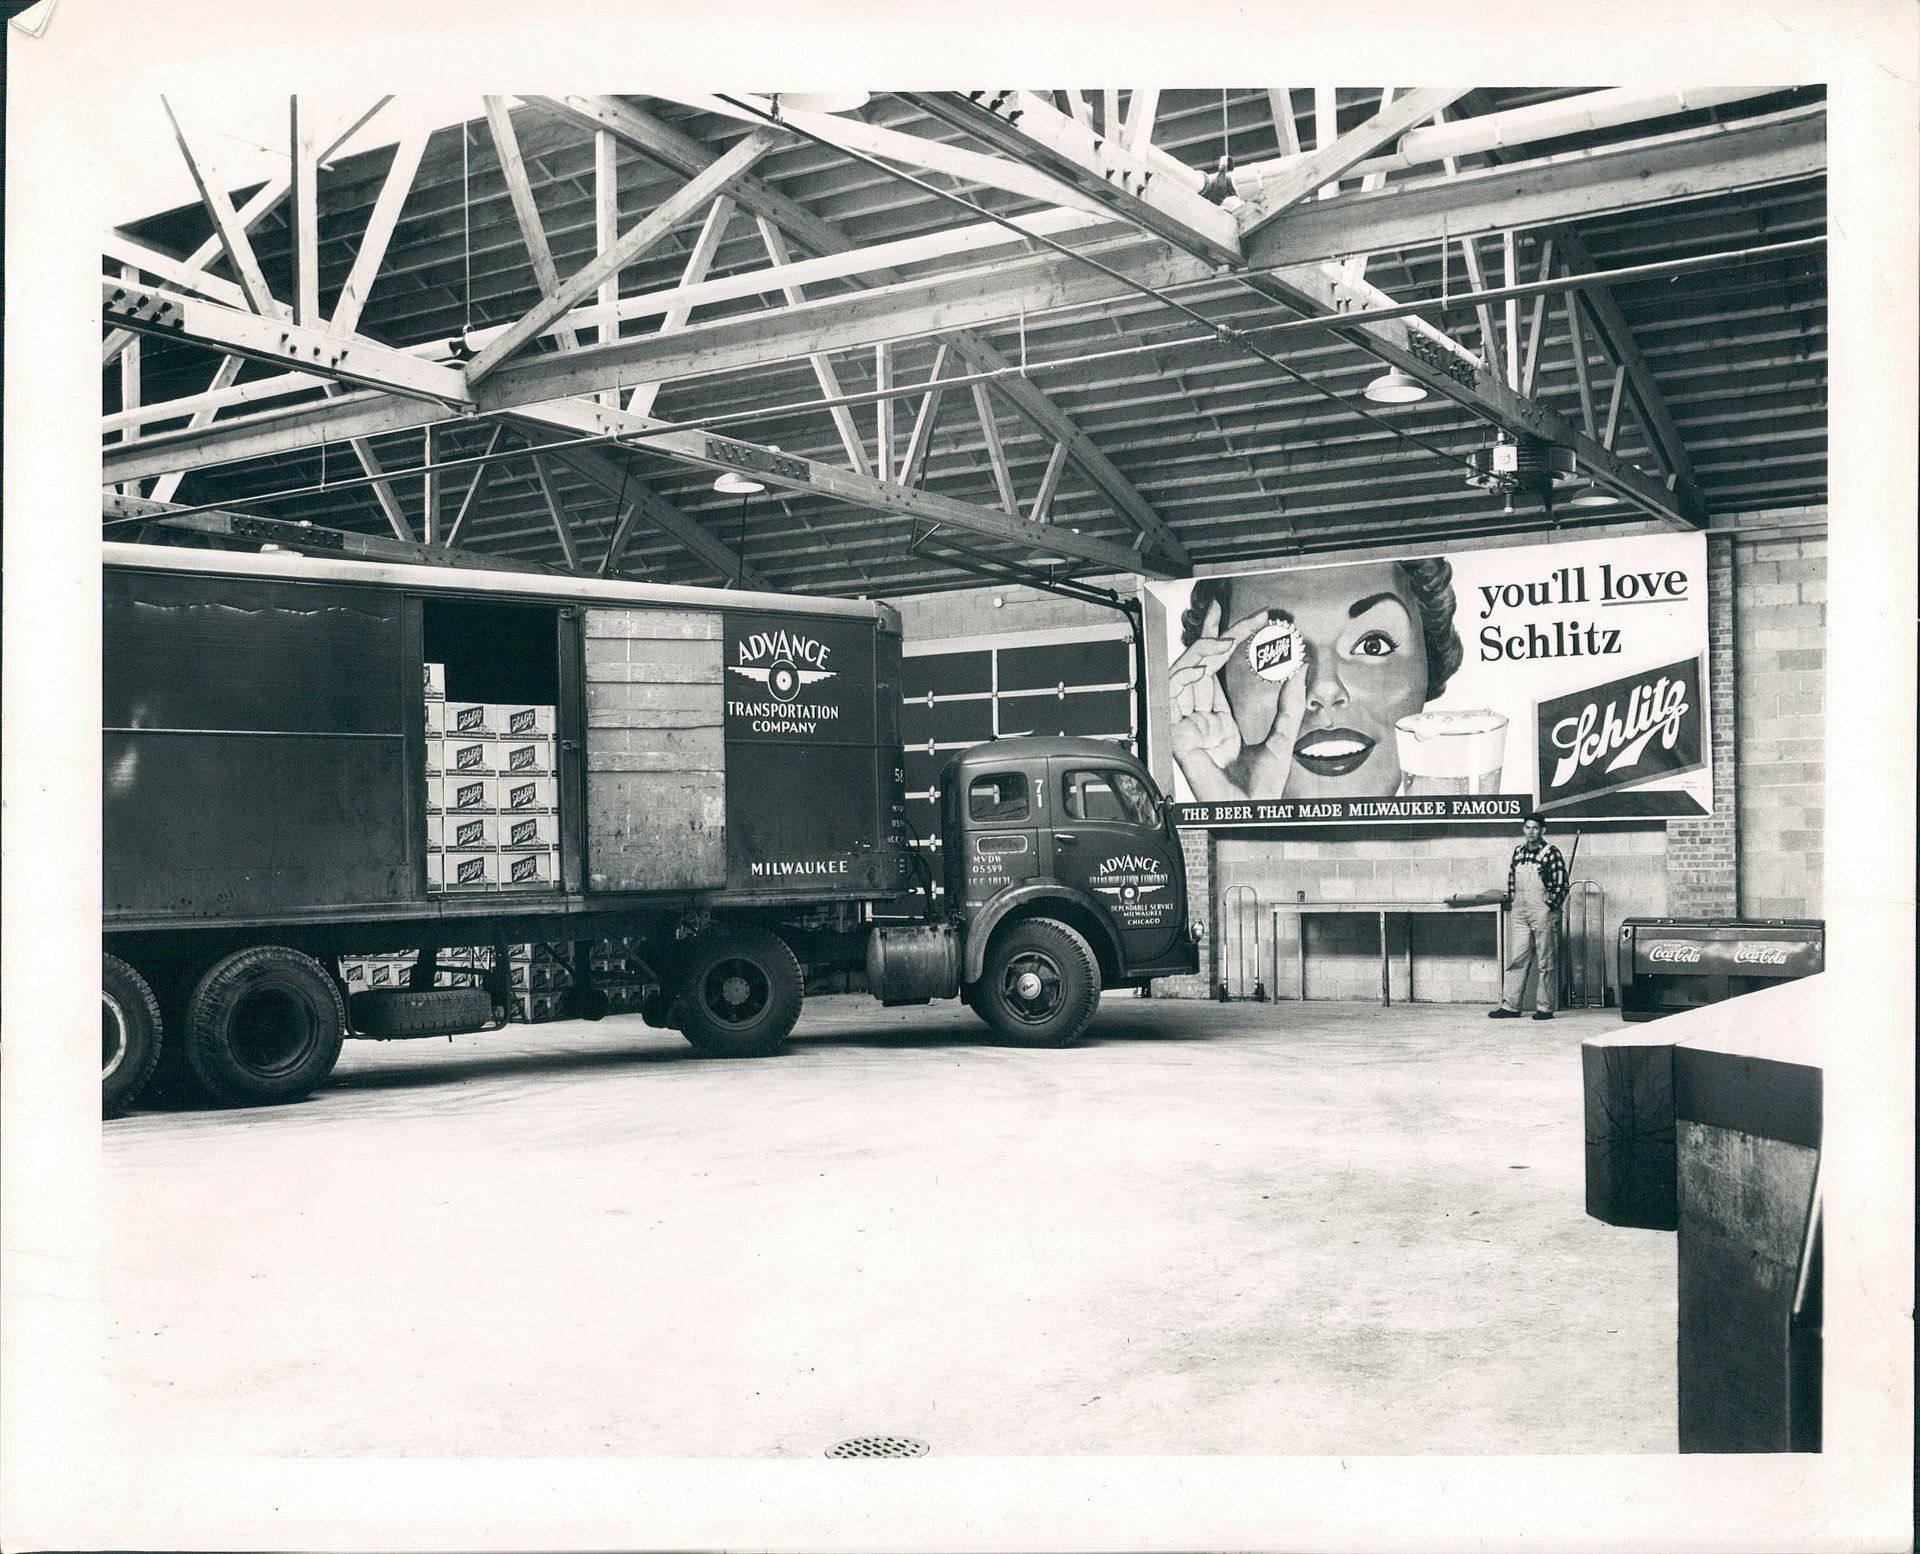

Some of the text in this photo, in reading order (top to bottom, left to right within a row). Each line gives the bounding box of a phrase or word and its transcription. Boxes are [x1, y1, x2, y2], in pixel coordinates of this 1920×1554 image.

[1478, 564, 1689, 619] you'll love
[738, 629, 832, 671] ADVANCE
[1479, 621, 1622, 662] Schlitz
[1257, 637, 1291, 669] Schlitz
[727, 701, 839, 720] TRANSPORTATION
[752, 720, 818, 733] COMPANY
[1550, 675, 1690, 788] Schlitz
[1182, 800, 1521, 821] THE BEER THAT MADE MILWAUKEE FAMOUS
[751, 860, 849, 876] MILWAUKEE
[1099, 854, 1161, 876] ADVANCE
[1110, 904, 1149, 912] DEPENDABLE
